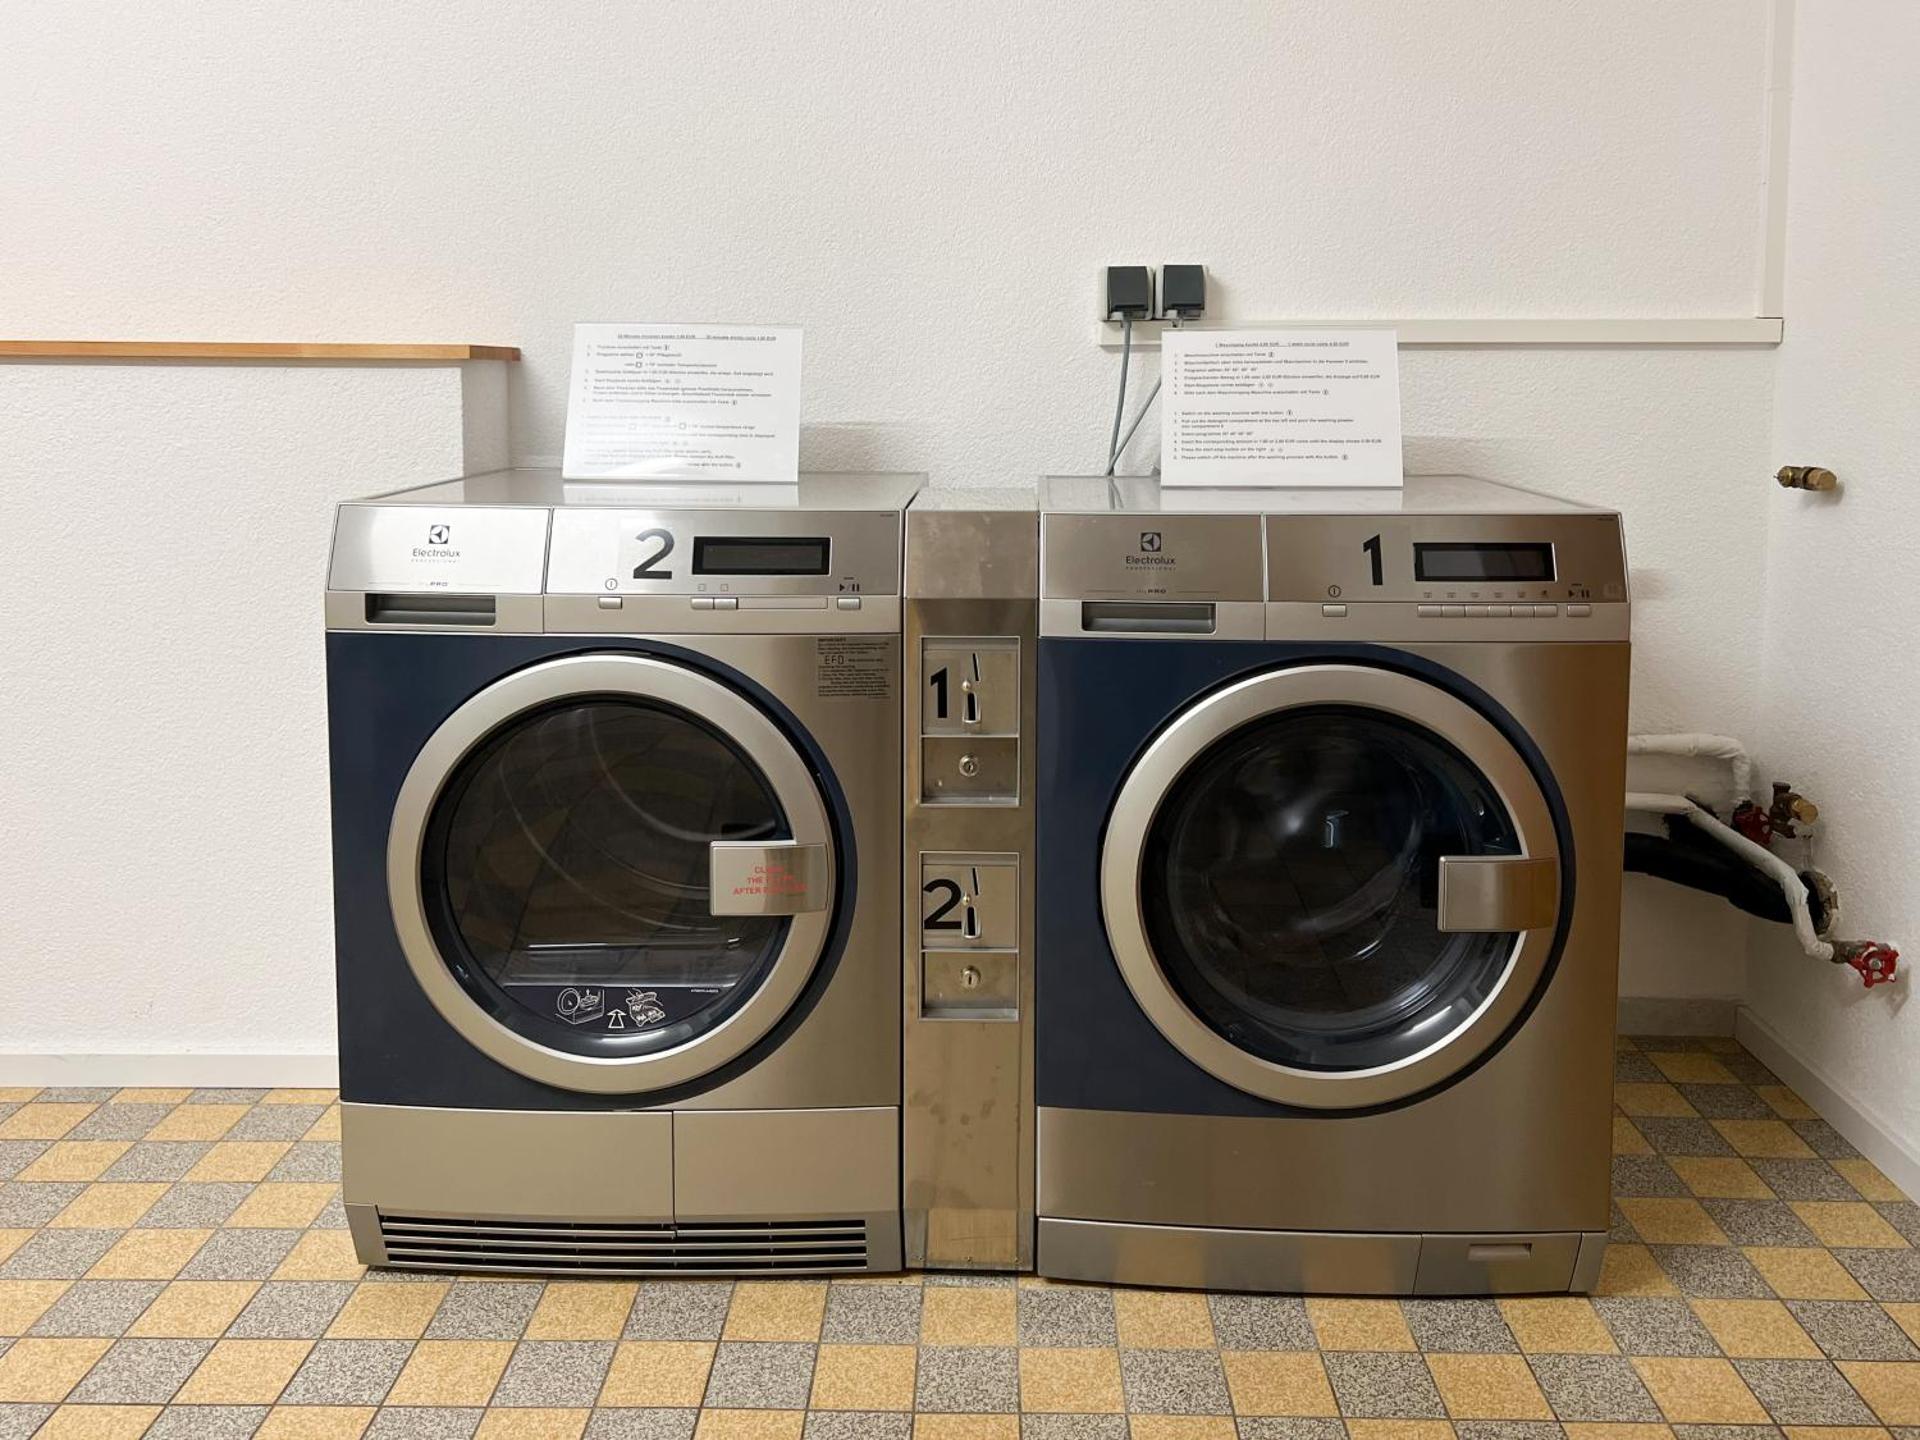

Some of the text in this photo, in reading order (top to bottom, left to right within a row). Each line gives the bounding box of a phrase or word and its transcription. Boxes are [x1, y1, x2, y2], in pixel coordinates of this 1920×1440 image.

[412, 547, 462, 558] Electrolux
[633, 528, 675, 579] 2
[1125, 554, 1176, 565] Electrolux
[1362, 534, 1384, 586] 1
[930, 667, 948, 719] 1
[923, 878, 962, 930] 2
